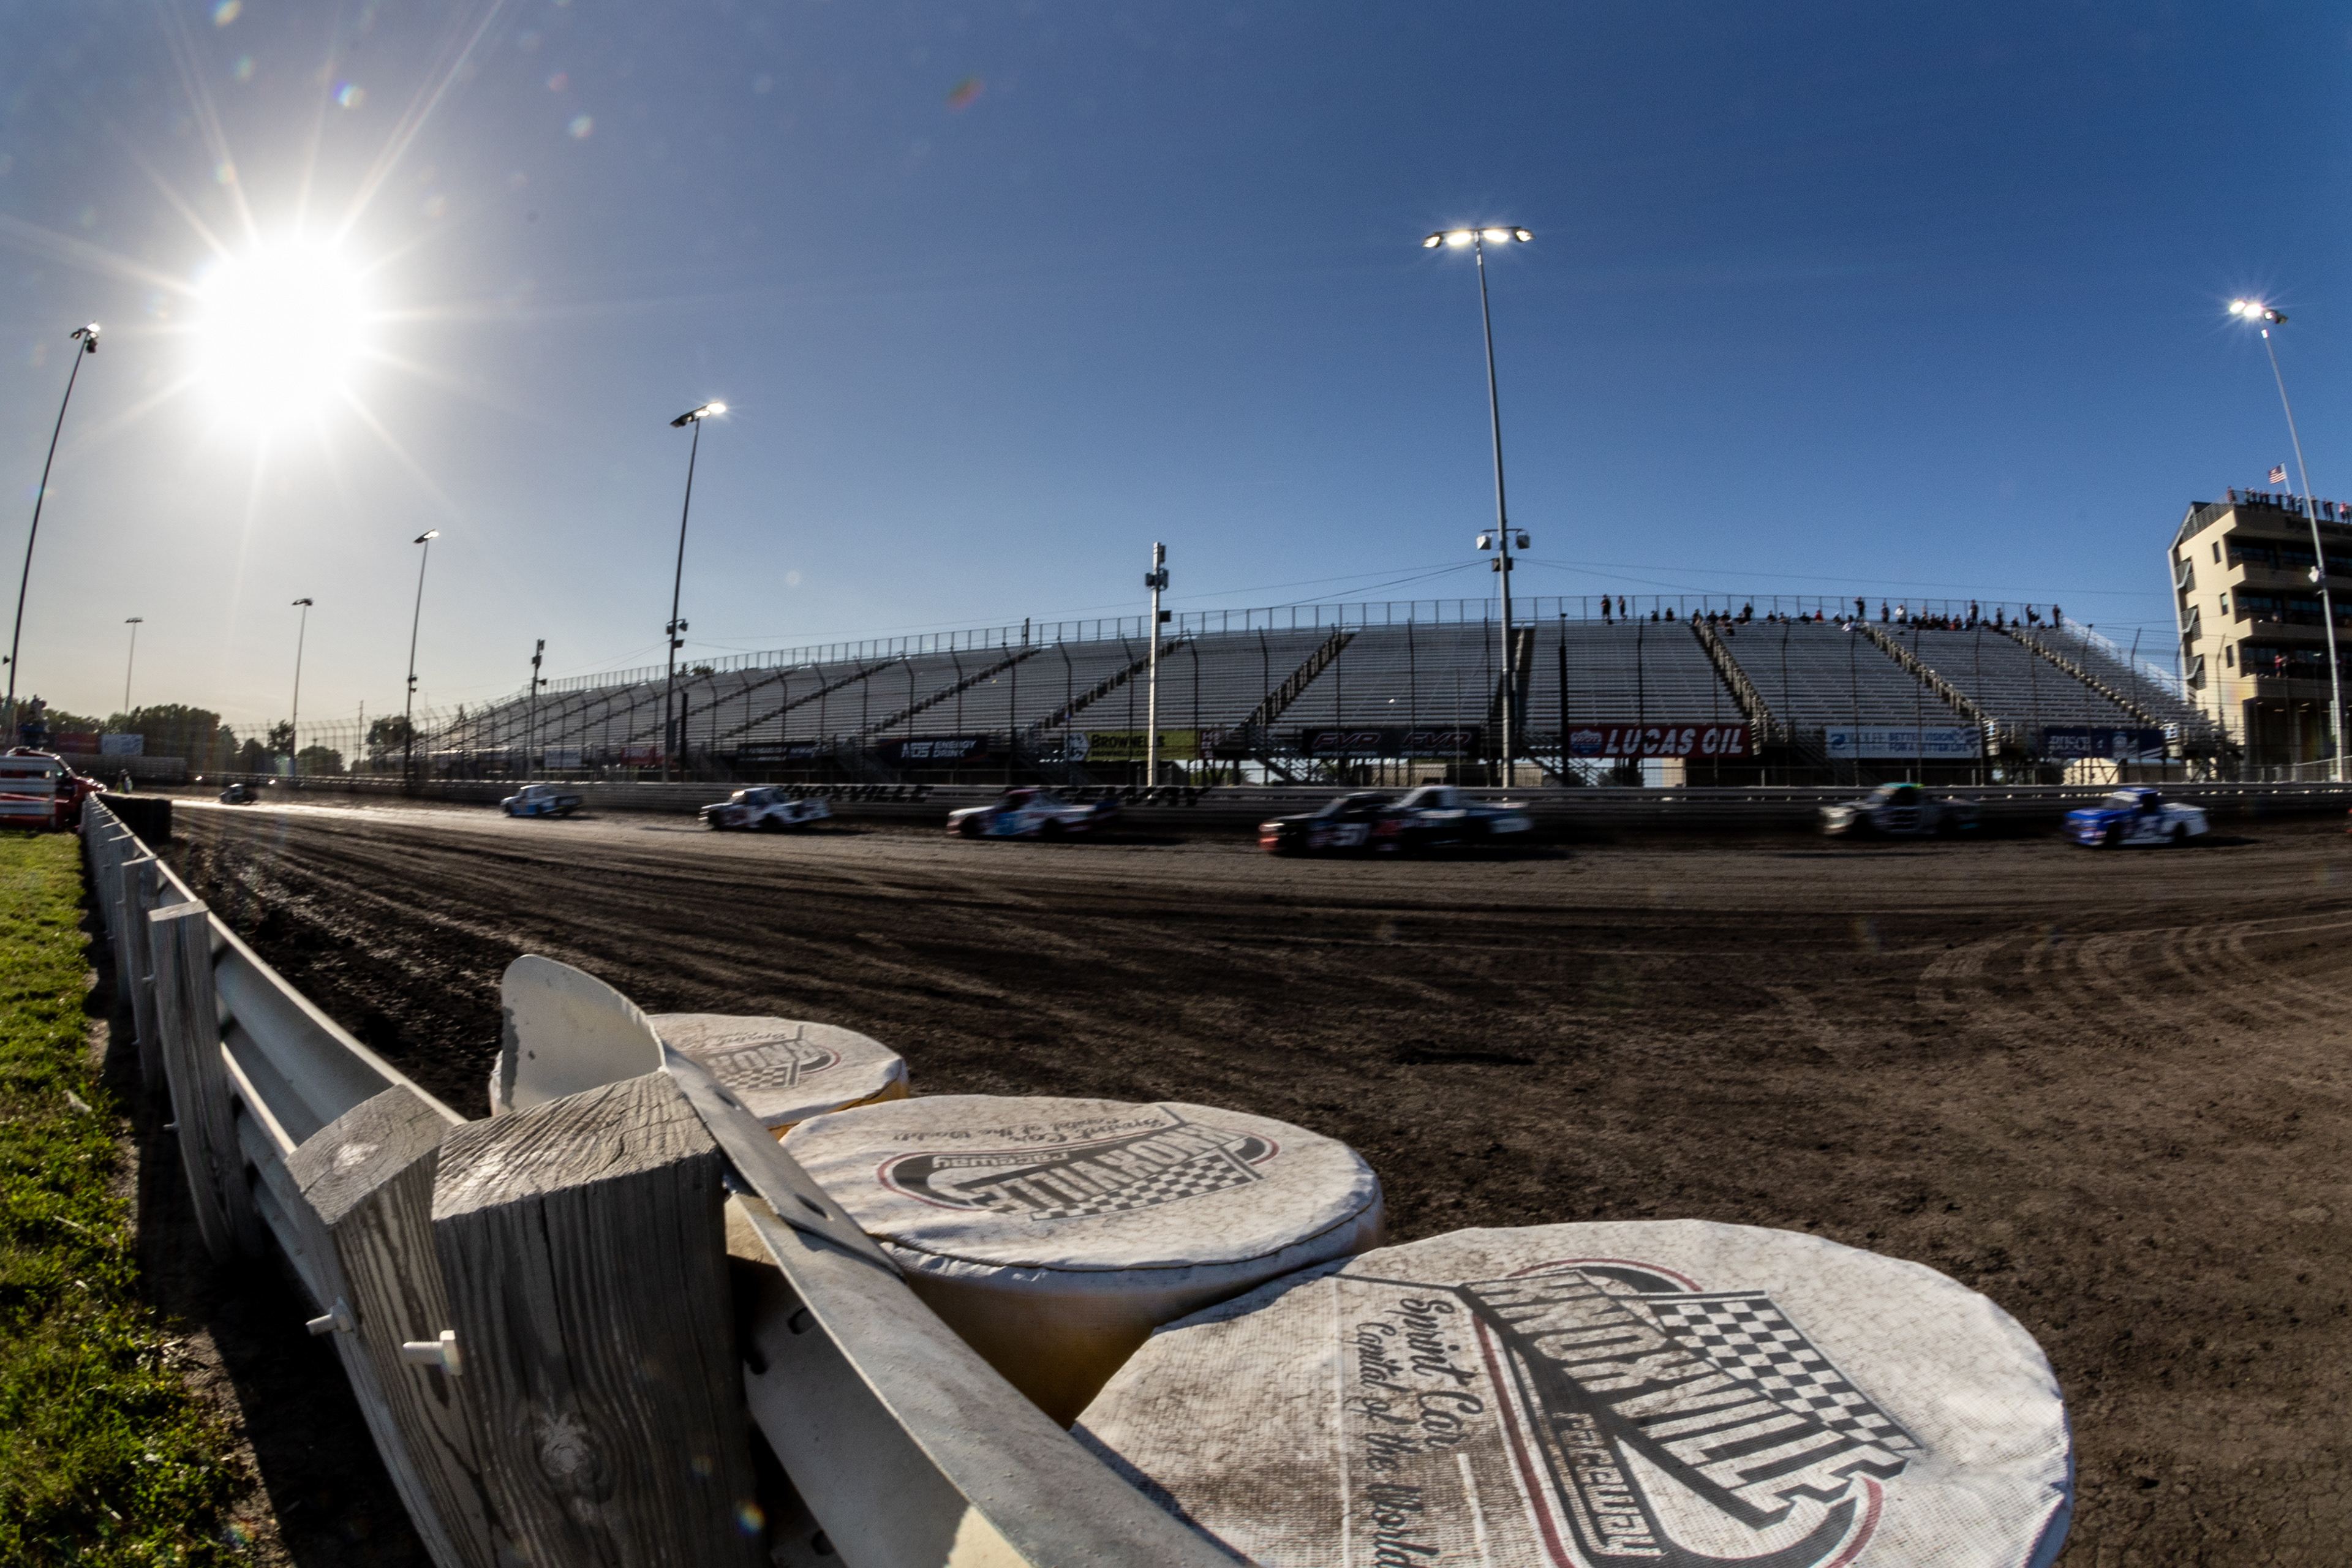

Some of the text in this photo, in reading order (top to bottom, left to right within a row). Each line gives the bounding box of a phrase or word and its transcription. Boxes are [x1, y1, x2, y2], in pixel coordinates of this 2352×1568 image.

[934, 739, 977, 749] ENERGY
[1091, 734, 1165, 748] BROWNELS
[1311, 732, 1381, 749] FVP
[1400, 731, 1472, 748] FVP
[1605, 728, 1744, 755] LUCAS OIL
[932, 748, 965, 758] DRINK
[977, 1128, 1012, 1137] the
[1007, 1117, 1166, 1144] Sprint Car
[1020, 1125, 1041, 1135] of
[1049, 1118, 1119, 1132] Capital
[932, 1152, 1069, 1170] raceway
[956, 1124, 1242, 1215] KNOXVILLE
[1345, 1321, 1411, 1392] Capital
[1385, 1298, 1485, 1451] Sprint Car
[1463, 1269, 1909, 1530] KNOXVILLE
[1349, 1396, 1414, 1426] of
[1365, 1431, 1423, 1474] the
[1551, 1409, 1665, 1557] raceway
